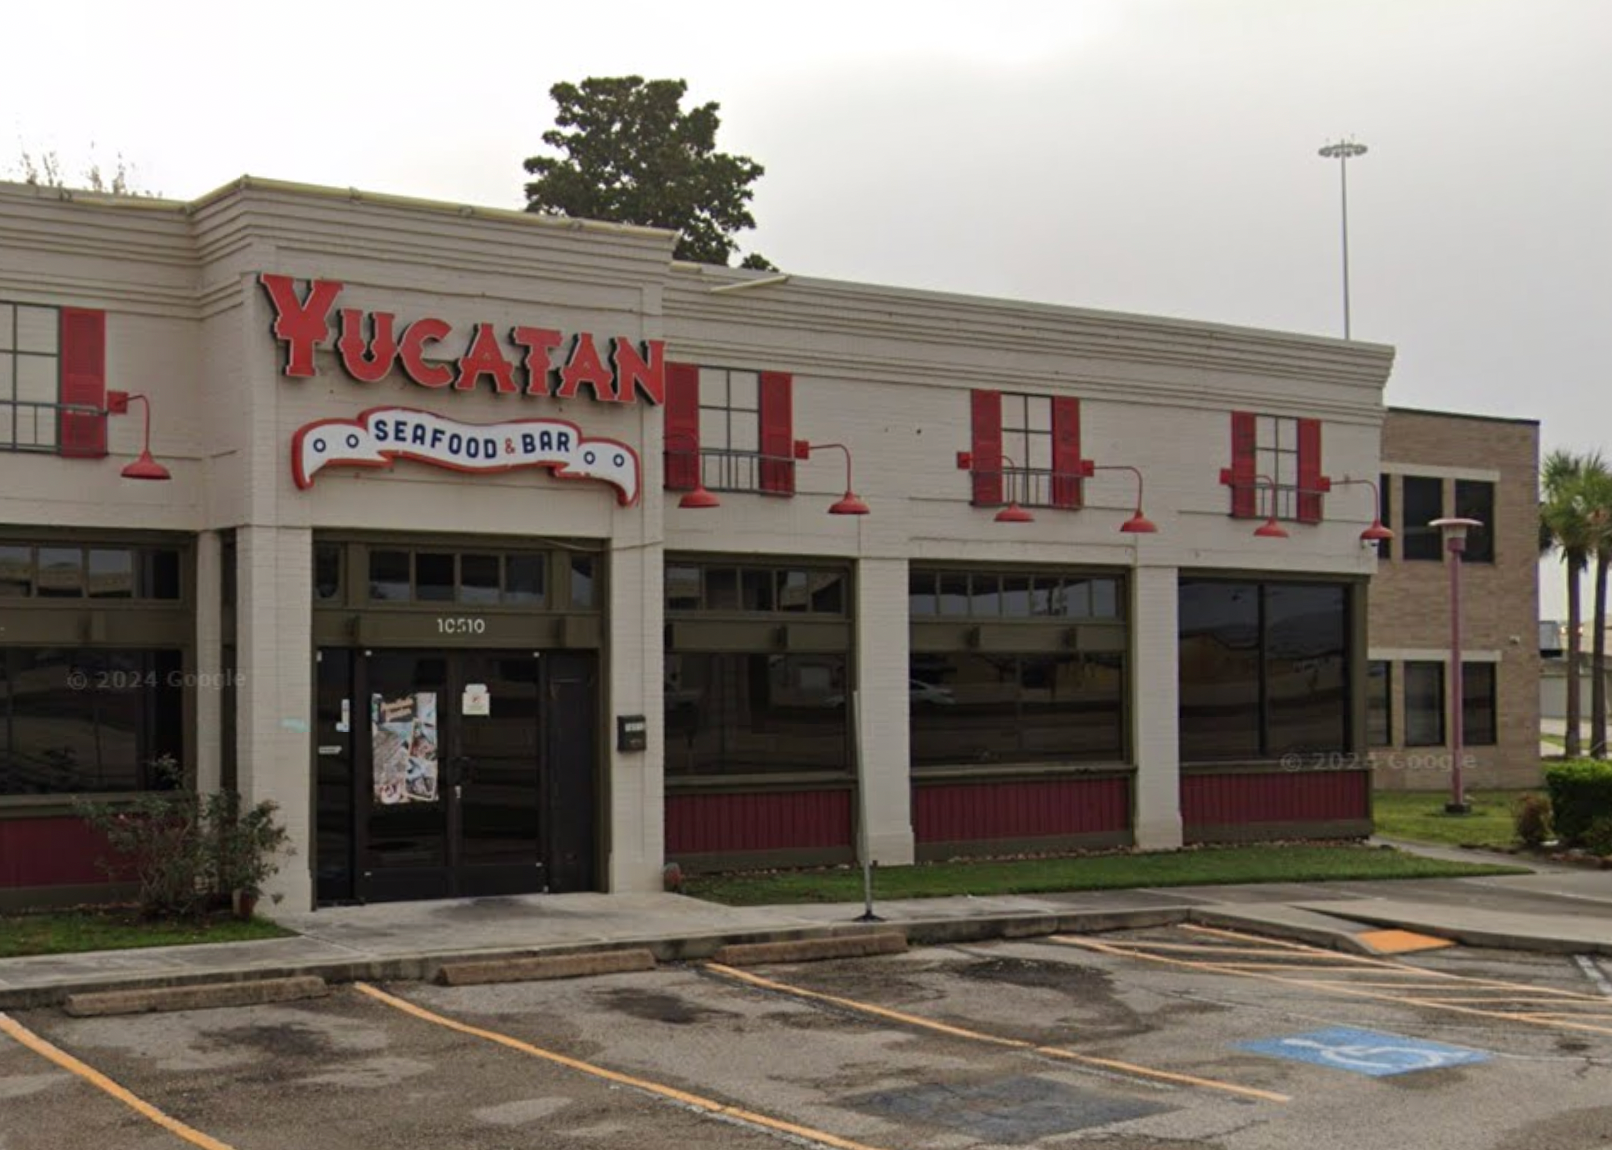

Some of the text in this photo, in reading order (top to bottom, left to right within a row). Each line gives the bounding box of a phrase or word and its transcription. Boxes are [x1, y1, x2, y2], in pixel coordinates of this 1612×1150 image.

[260, 273, 666, 405] YUCATAN
[374, 420, 571, 459] SEAFOOD & BAR
